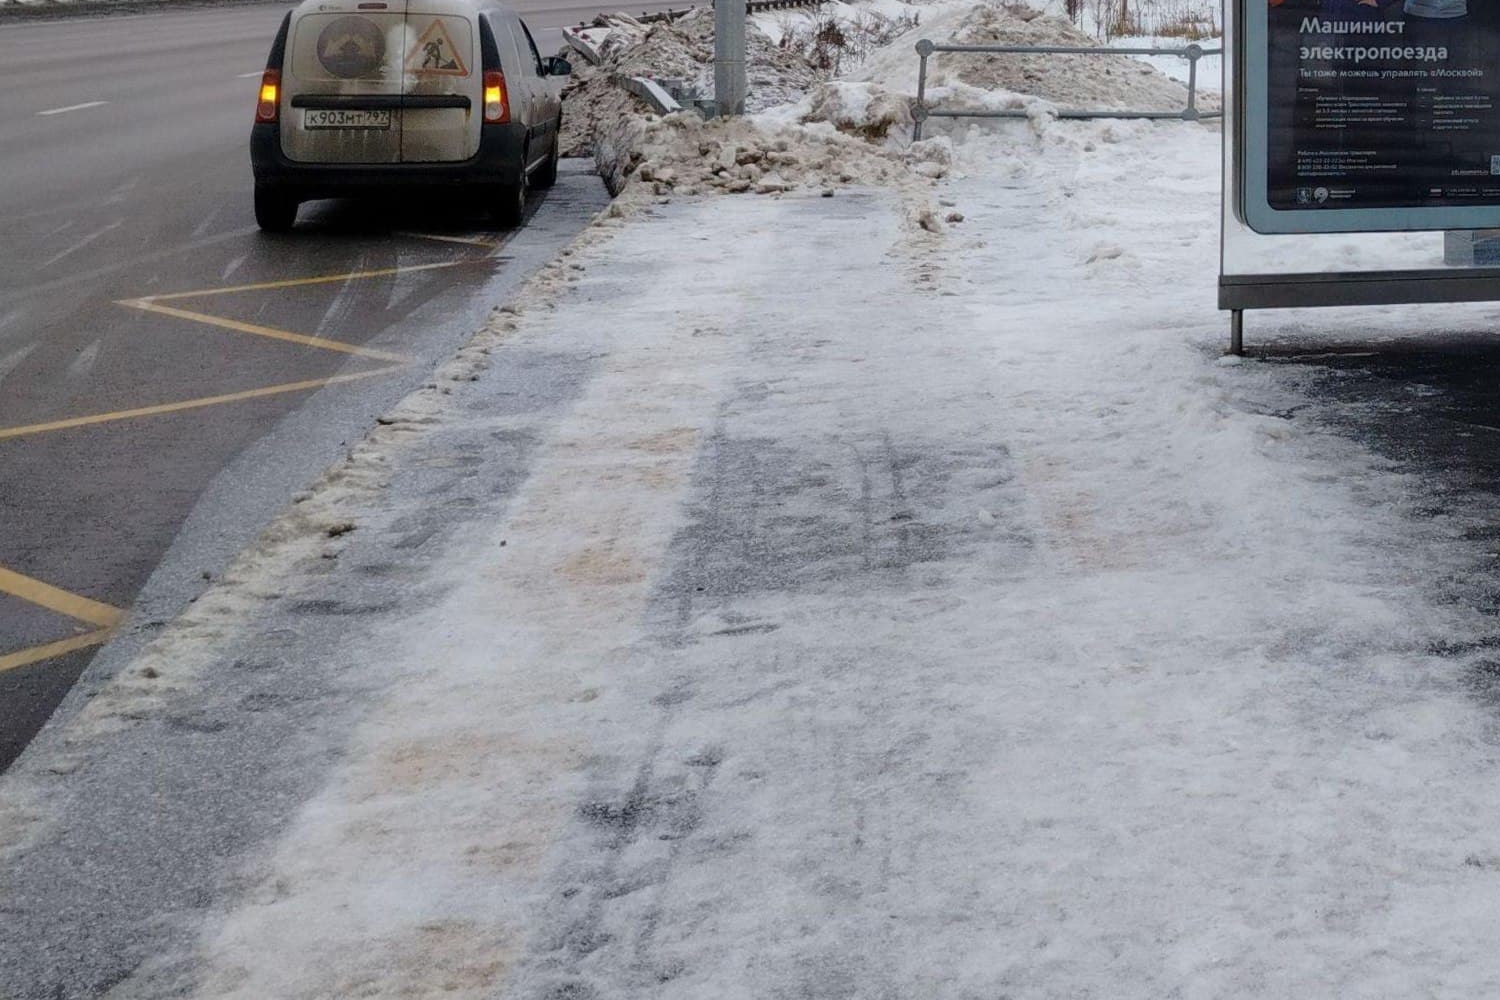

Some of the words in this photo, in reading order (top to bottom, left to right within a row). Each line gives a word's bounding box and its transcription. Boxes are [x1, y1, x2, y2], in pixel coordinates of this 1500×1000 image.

[1299, 17, 1406, 34] Машинист
[1299, 46, 1448, 63] электропоезда
[1300, 68, 1312, 78] Ты
[1313, 69, 1337, 78] тоже
[1339, 69, 1380, 78] можешь
[1381, 70, 1428, 80] управлять
